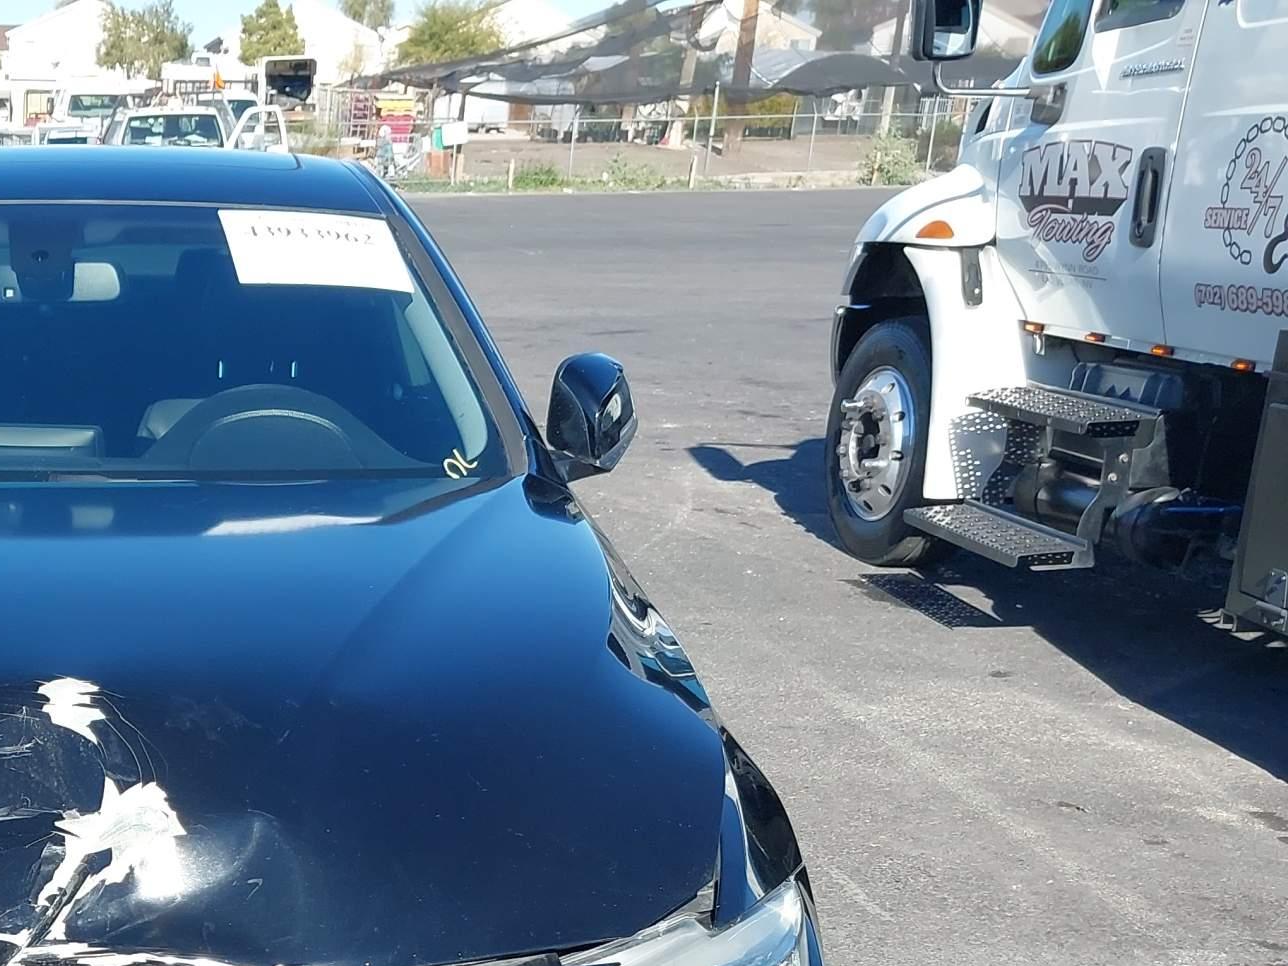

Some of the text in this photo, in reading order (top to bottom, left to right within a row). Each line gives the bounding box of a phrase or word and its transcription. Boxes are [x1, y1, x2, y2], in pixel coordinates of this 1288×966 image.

[1019, 139, 1133, 200] MAX
[1239, 147, 1288, 239] 24/7
[1027, 204, 1115, 262] Towing
[1204, 207, 1250, 230] SERVICE
[1194, 283, 1226, 311] (702)
